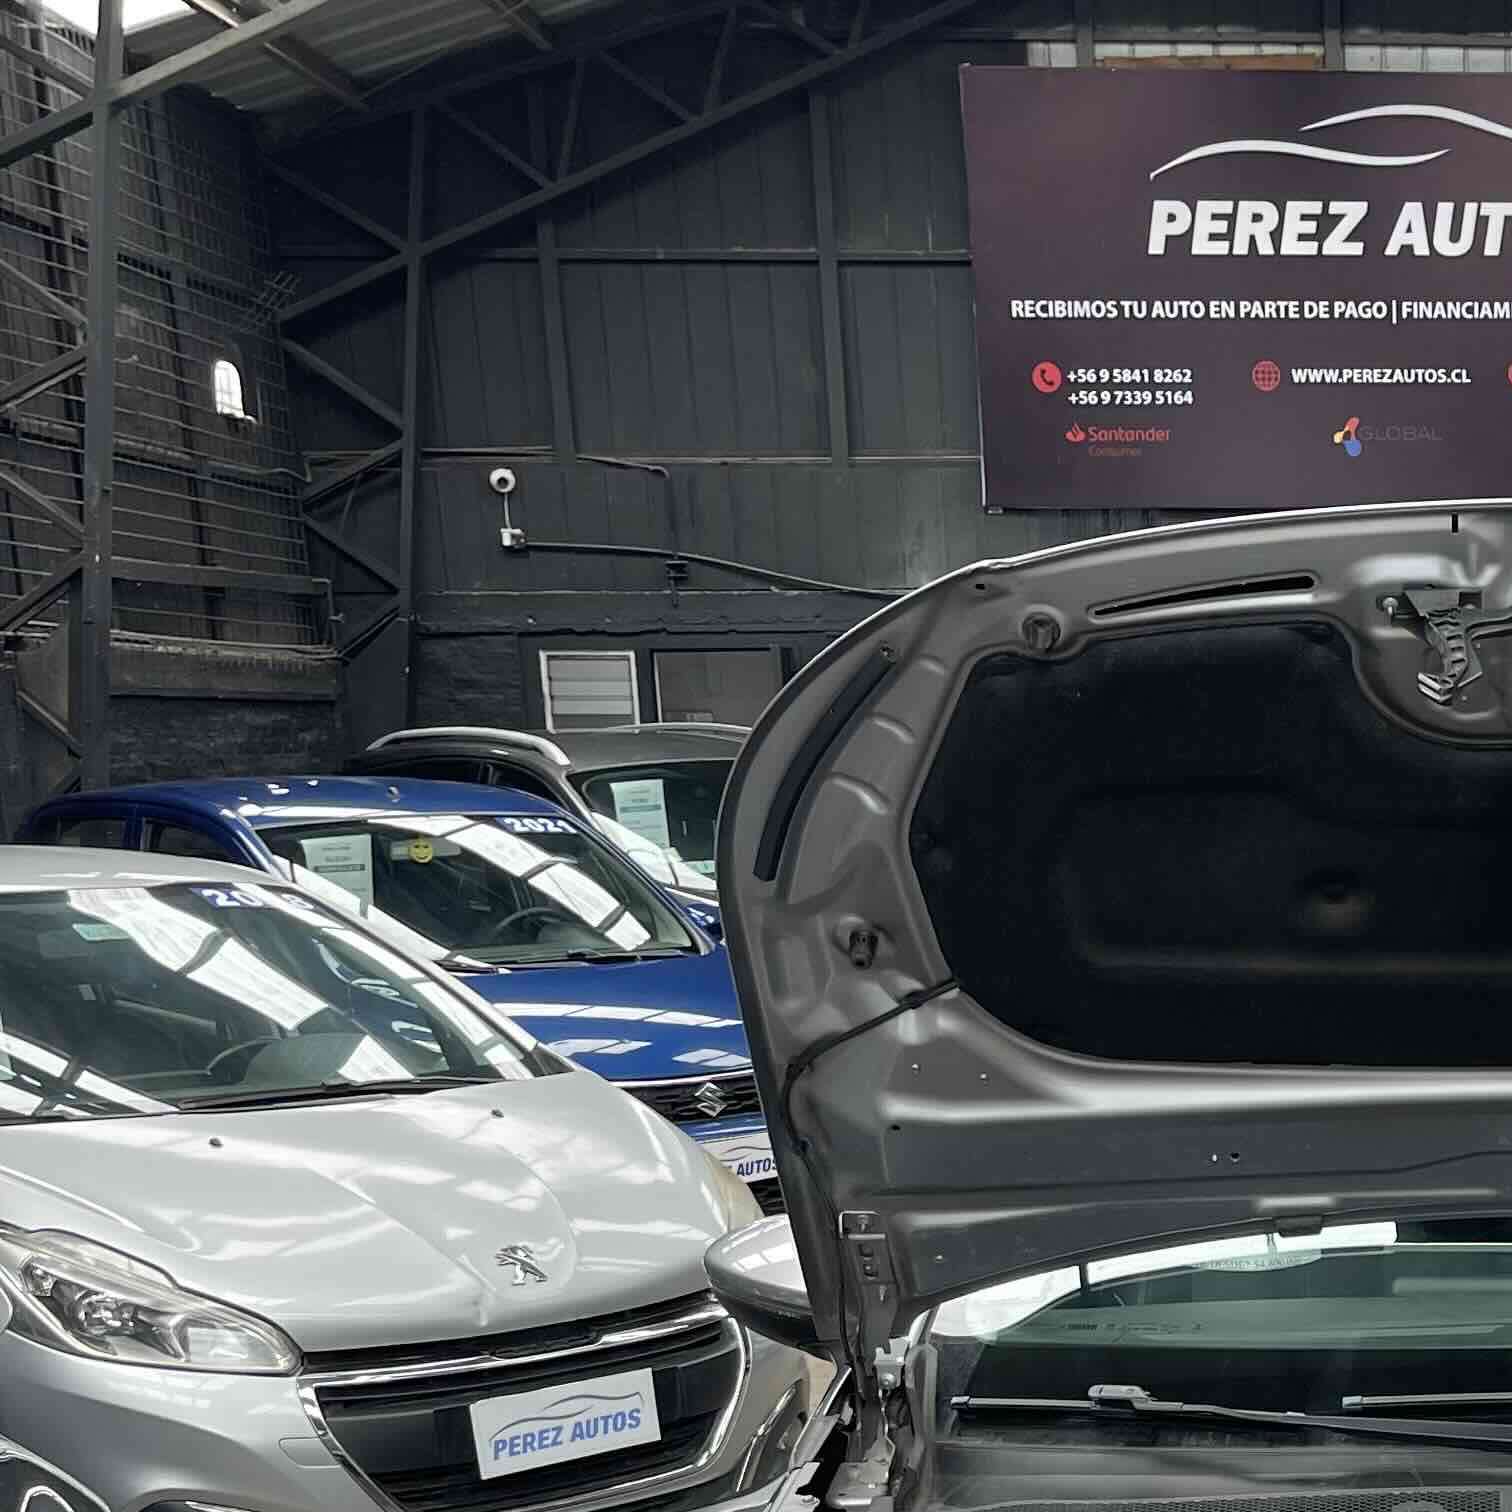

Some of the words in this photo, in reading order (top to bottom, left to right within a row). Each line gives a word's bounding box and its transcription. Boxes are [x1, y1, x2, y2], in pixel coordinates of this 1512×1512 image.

[1147, 199, 1369, 257] PEREZ
[1011, 299, 1118, 319] RECIBIMOS
[1120, 300, 1147, 319] TU
[1151, 300, 1206, 319] AUTO
[1209, 300, 1235, 319] EN
[1239, 300, 1300, 319] PARTE
[1303, 300, 1330, 319] DE
[1333, 300, 1388, 319] PAGO
[1066, 368, 1098, 383] +56
[1099, 368, 1110, 383] 9
[1112, 368, 1149, 383] 5841
[1153, 368, 1193, 383] 8262
[1291, 368, 1472, 384] WWW.PEREZAUTOS.CL
[1067, 390, 1099, 405] +56
[1100, 390, 1112, 405] 9
[1113, 390, 1153, 405] 7339
[1155, 390, 1194, 405] 5164
[1088, 426, 1171, 441] Santander
[1360, 425, 1443, 441] GLOBAL
[503, 817, 578, 834] 2021
[493, 1425, 564, 1461] PEREZ
[569, 1407, 641, 1443] AUTOS
